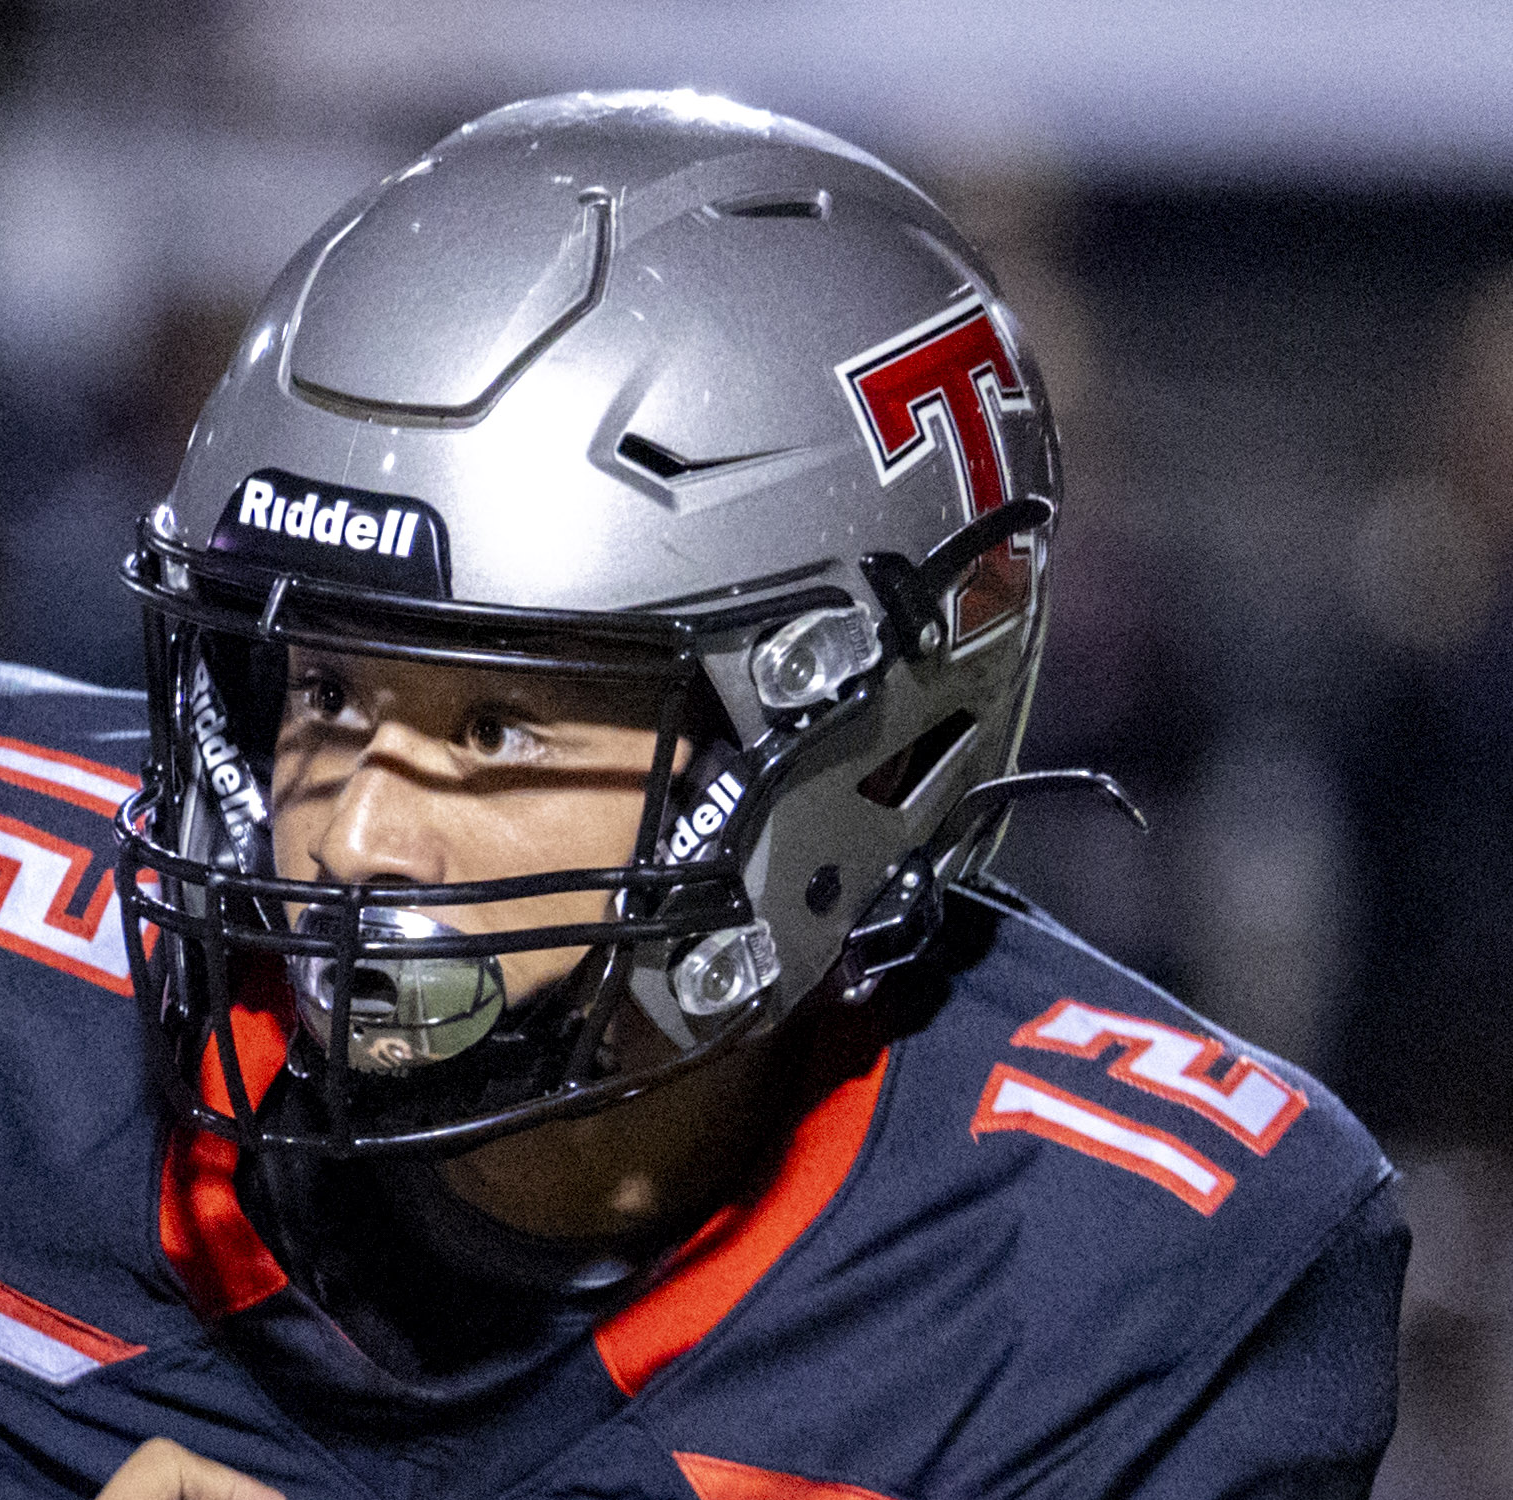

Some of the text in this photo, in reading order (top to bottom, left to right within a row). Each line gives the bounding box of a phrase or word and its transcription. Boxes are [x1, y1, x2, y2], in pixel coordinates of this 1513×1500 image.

[238, 478, 421, 558] Riddell
[834, 292, 1036, 662] T
[189, 657, 267, 826] Riddell
[655, 771, 745, 866] dell
[970, 998, 1308, 1217] 12
